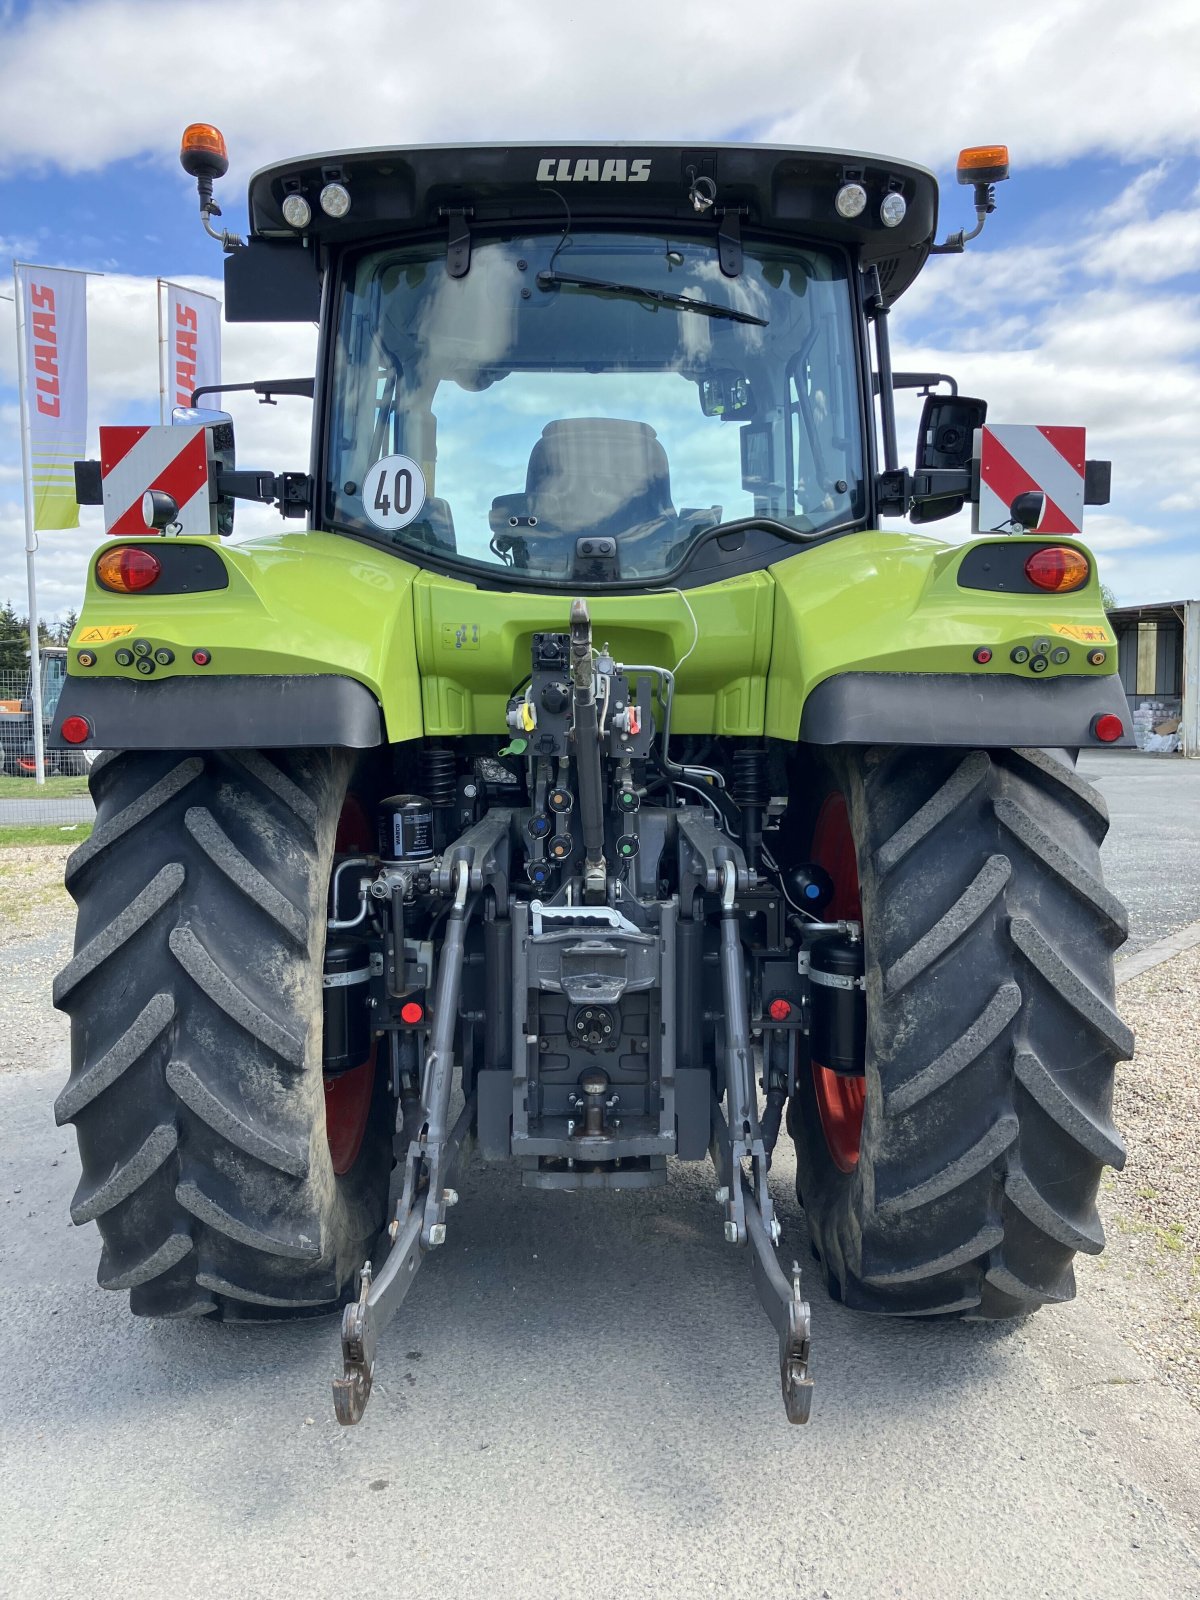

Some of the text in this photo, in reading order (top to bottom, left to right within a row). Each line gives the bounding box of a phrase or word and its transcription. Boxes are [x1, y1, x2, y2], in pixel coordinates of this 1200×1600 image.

[536, 159, 652, 181] CLAAS
[31, 283, 60, 418] CLAAS
[175, 302, 198, 408] LAAS
[374, 468, 412, 516] 40
